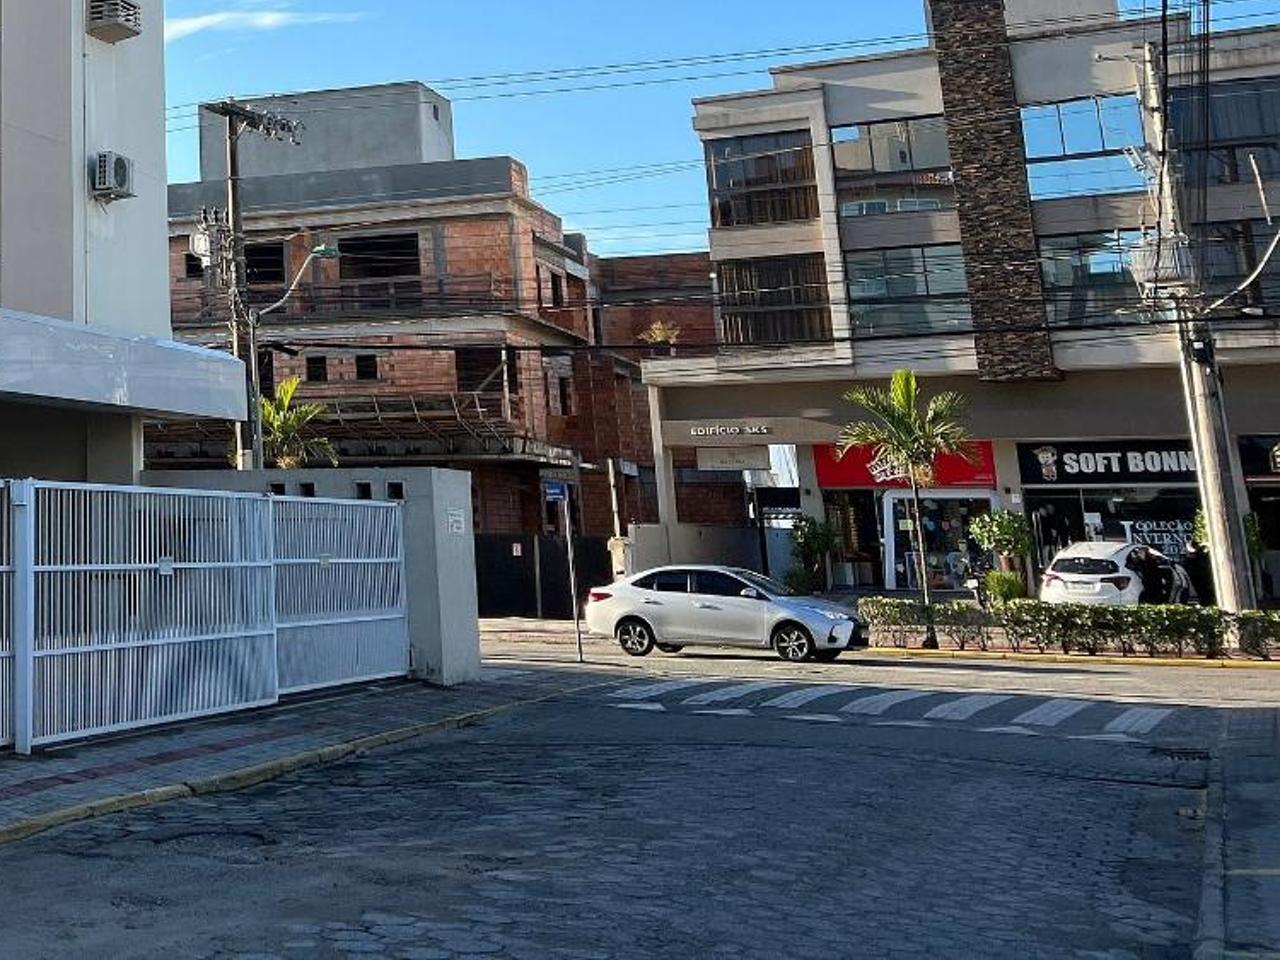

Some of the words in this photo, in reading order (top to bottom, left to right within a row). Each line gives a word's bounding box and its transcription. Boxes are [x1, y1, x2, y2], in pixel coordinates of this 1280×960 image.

[1063, 452, 1121, 473] SOFT
[1126, 450, 1197, 473] BONN
[1135, 519, 1194, 532] COLEÇÃO
